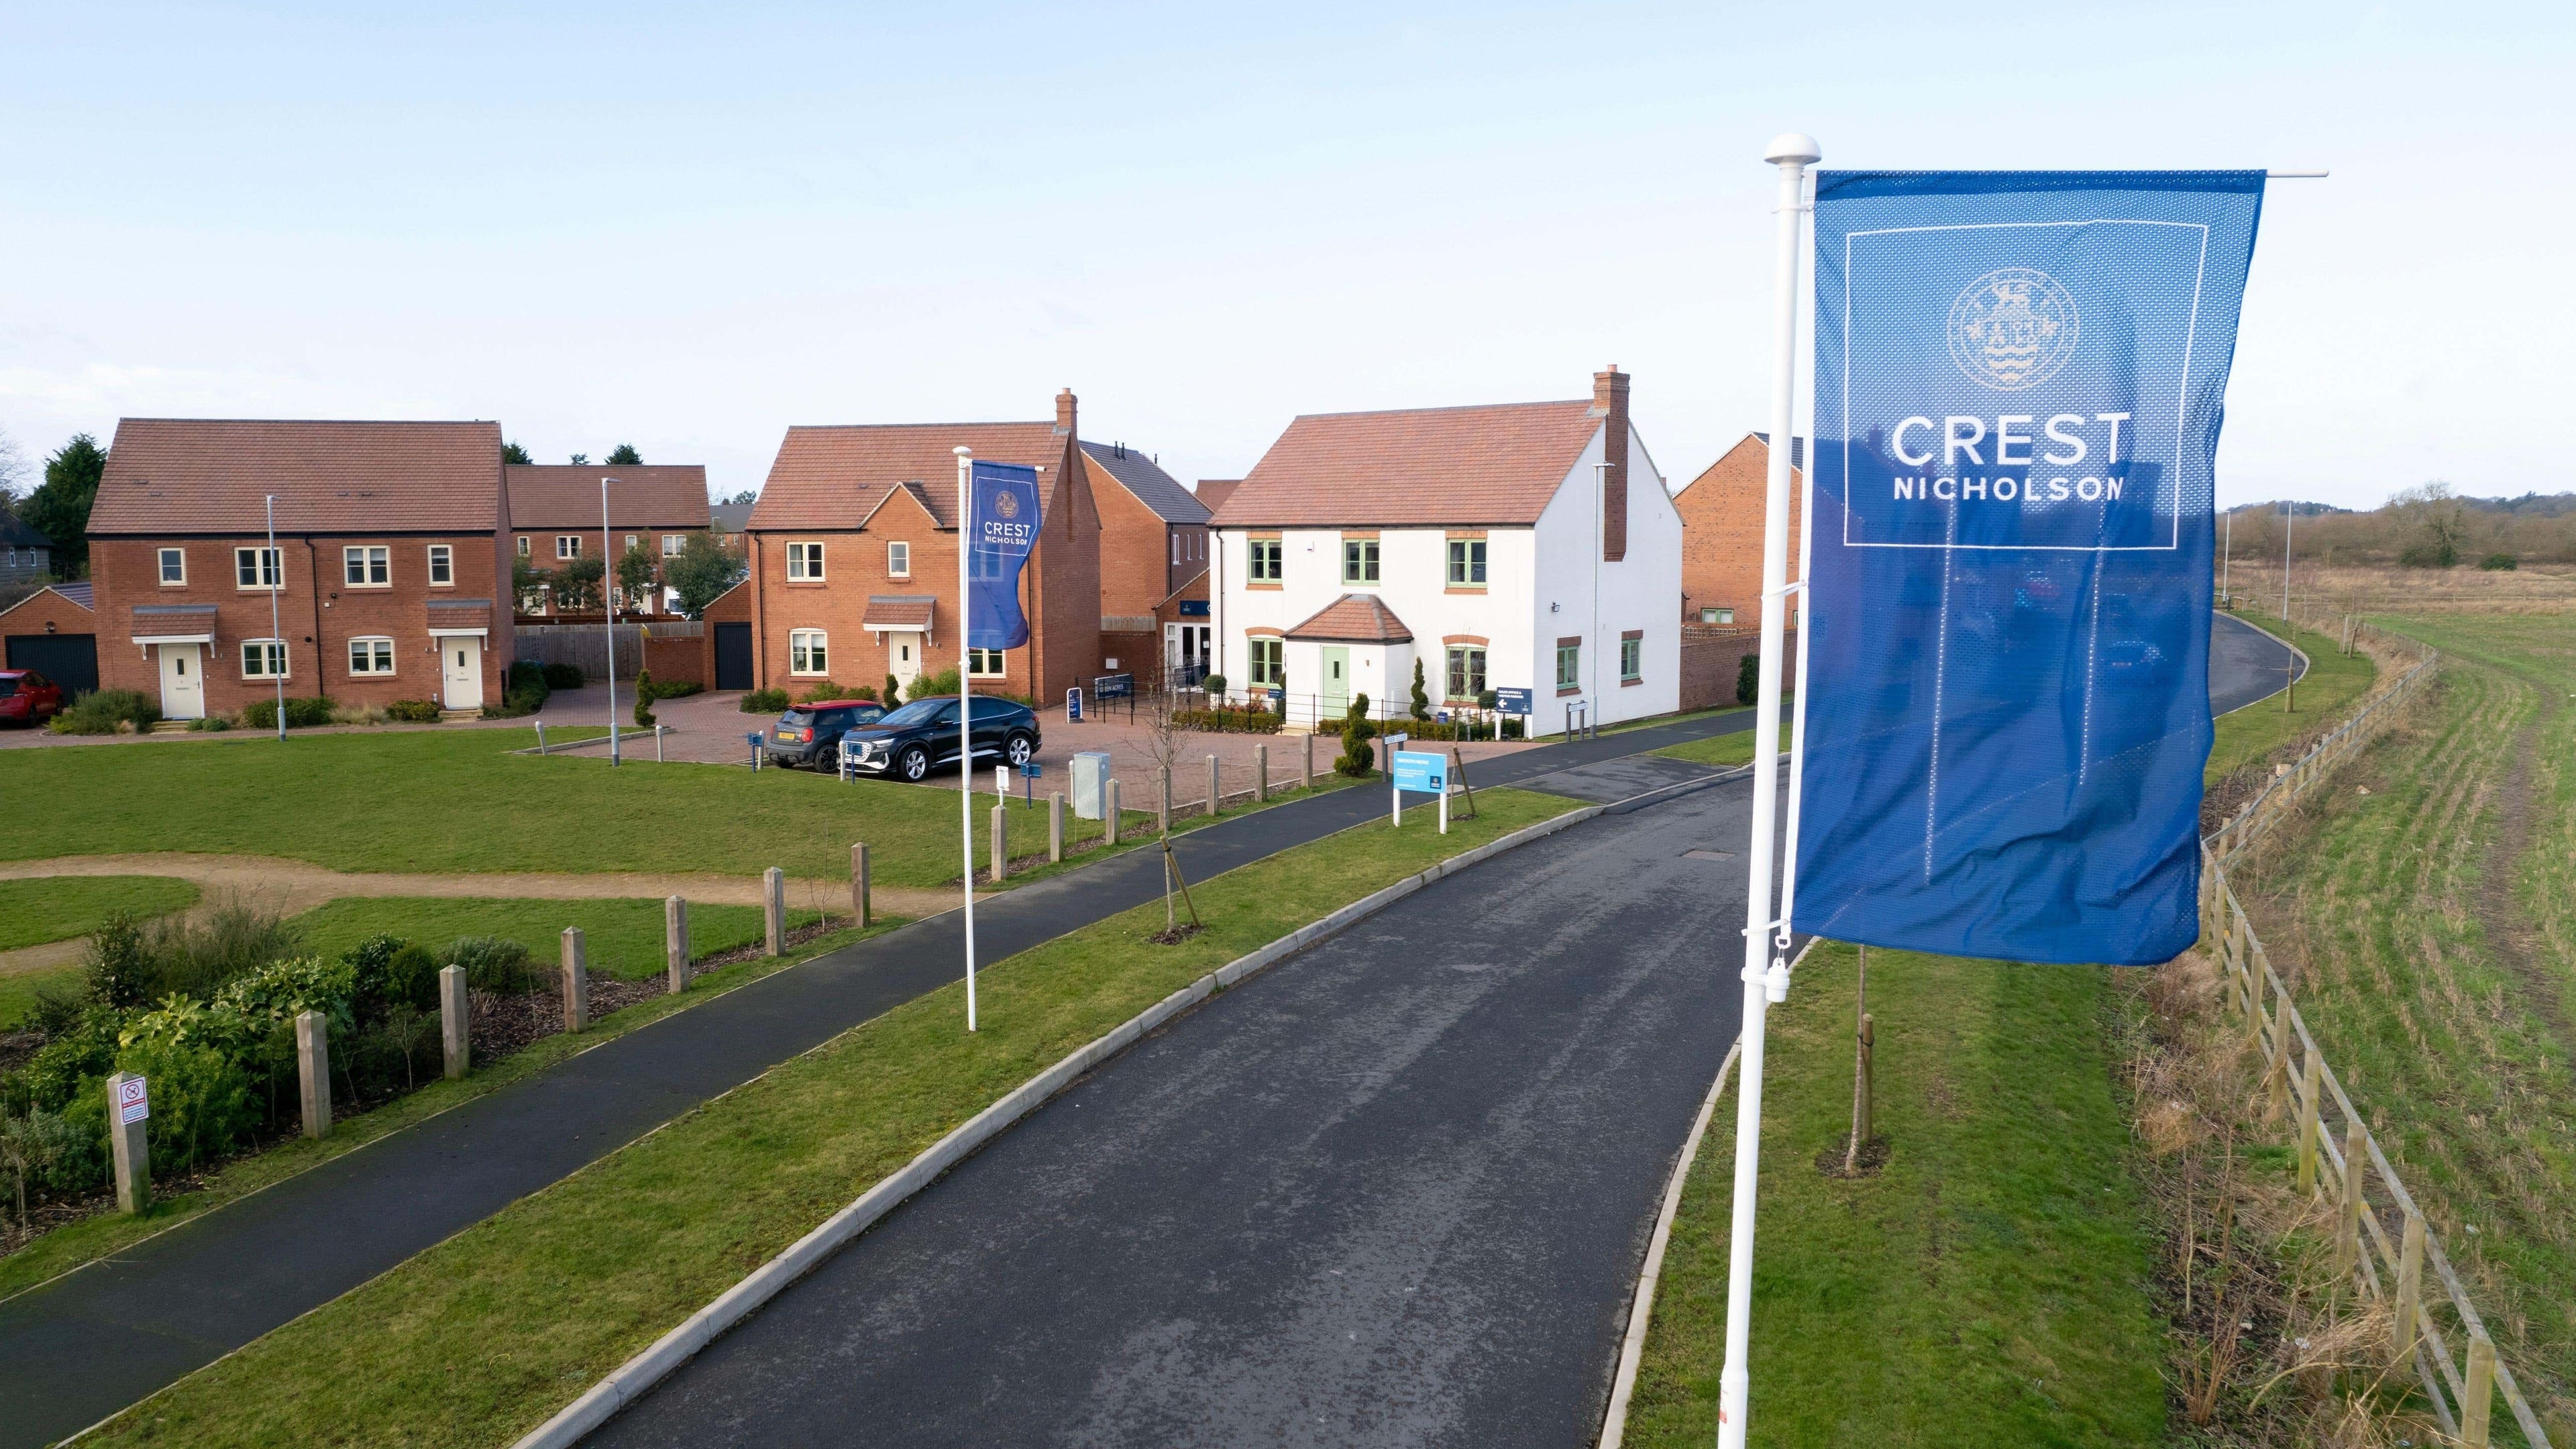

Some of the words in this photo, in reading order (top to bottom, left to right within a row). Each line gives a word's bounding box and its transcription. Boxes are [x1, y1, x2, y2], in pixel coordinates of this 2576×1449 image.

[1892, 412, 2131, 466] CREST
[1894, 476, 2124, 501] NICHOLSON
[985, 521, 1030, 537] CREST
[985, 535, 1028, 545] NICHOLSON
